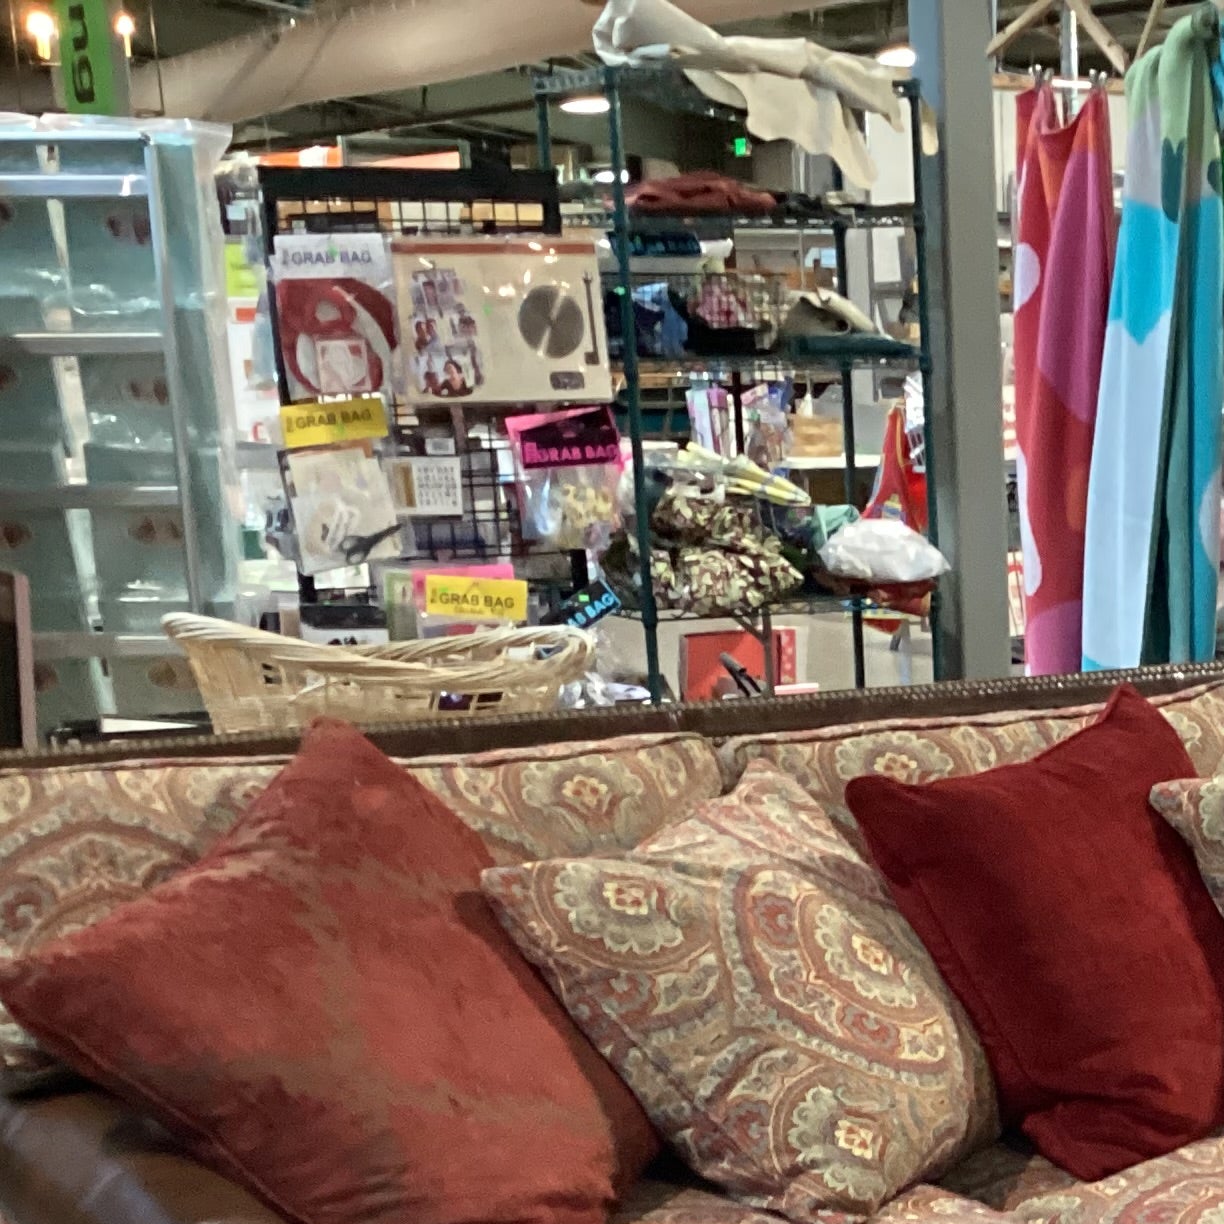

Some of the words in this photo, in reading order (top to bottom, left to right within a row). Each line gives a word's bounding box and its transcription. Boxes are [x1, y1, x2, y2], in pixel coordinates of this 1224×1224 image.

[291, 250, 335, 265] GRAB
[340, 250, 372, 265] BAG
[295, 412, 337, 429] GRAB
[341, 408, 372, 424] BAG
[539, 446, 582, 462] GRAB
[585, 443, 619, 460] BAG
[439, 591, 480, 606] GRAB
[484, 594, 515, 609] BAG
[568, 612, 587, 627] AB
[584, 592, 615, 619] BAG
